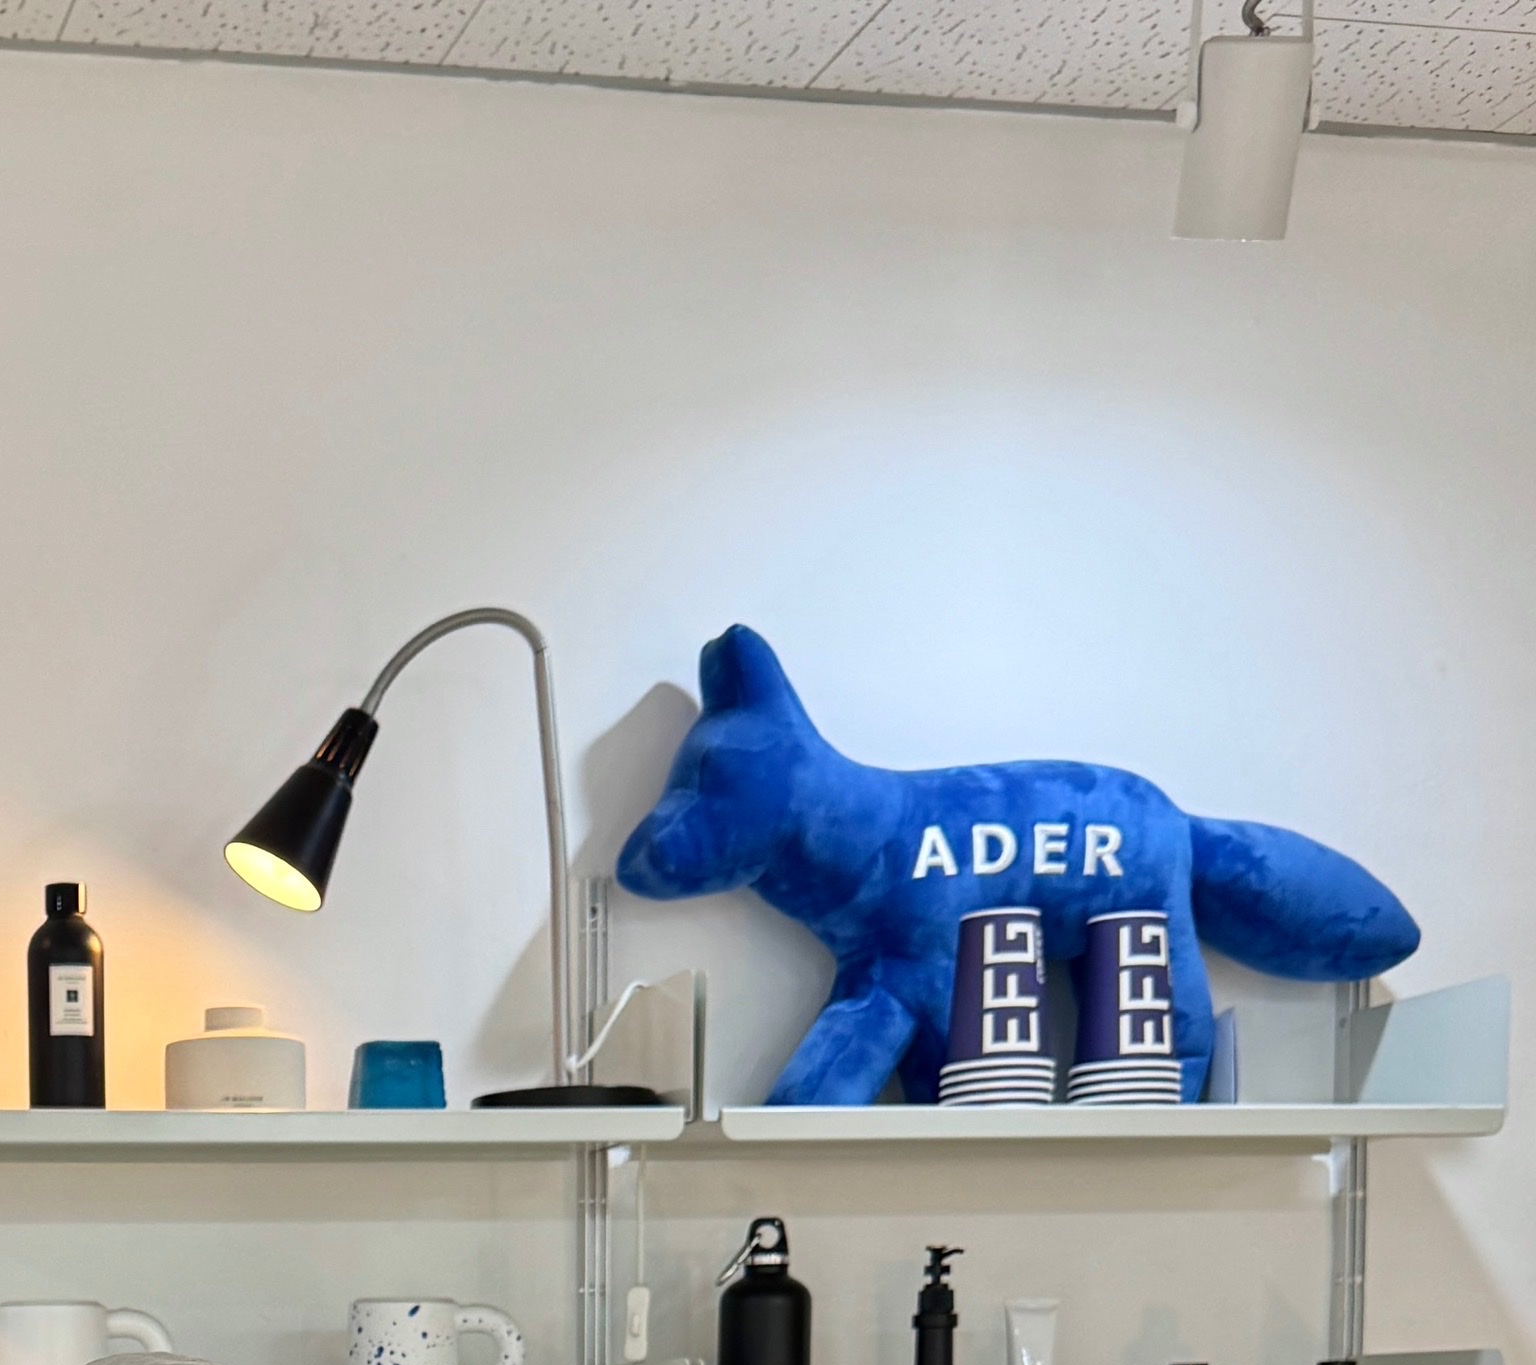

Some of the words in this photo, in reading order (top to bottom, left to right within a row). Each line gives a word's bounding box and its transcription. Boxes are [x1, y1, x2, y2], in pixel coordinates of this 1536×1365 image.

[912, 822, 1124, 880] ADER
[981, 920, 1041, 1055] EFG
[1119, 923, 1172, 1055] EFG
